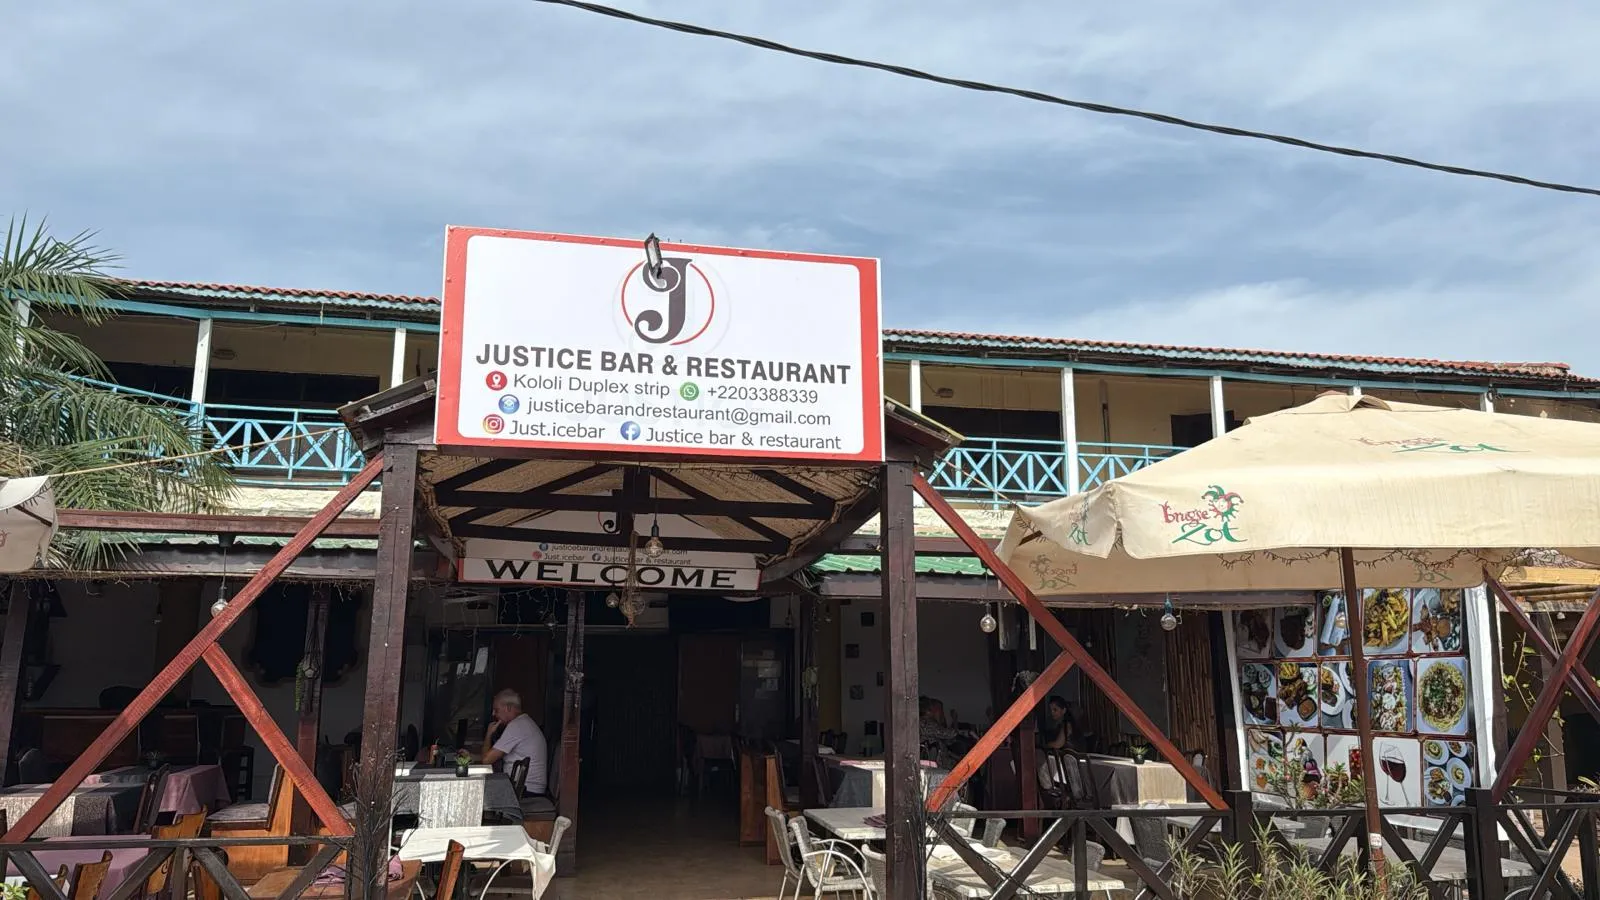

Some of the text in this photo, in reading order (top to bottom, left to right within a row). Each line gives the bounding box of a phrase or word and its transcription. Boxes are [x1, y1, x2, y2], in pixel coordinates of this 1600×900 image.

[476, 343, 851, 384] JUSTICE BAR & RESTAURANT
[513, 374, 819, 403] Kololi Duplex strip +2203388339
[526, 397, 831, 426] justicebarandrestaurant@gmail.com
[509, 420, 842, 450] Just.icebar Justice bar & restaurant
[1172, 521, 1248, 546] Zot
[485, 559, 737, 588] WELCOME
[654, 557, 691, 565] restaurant
